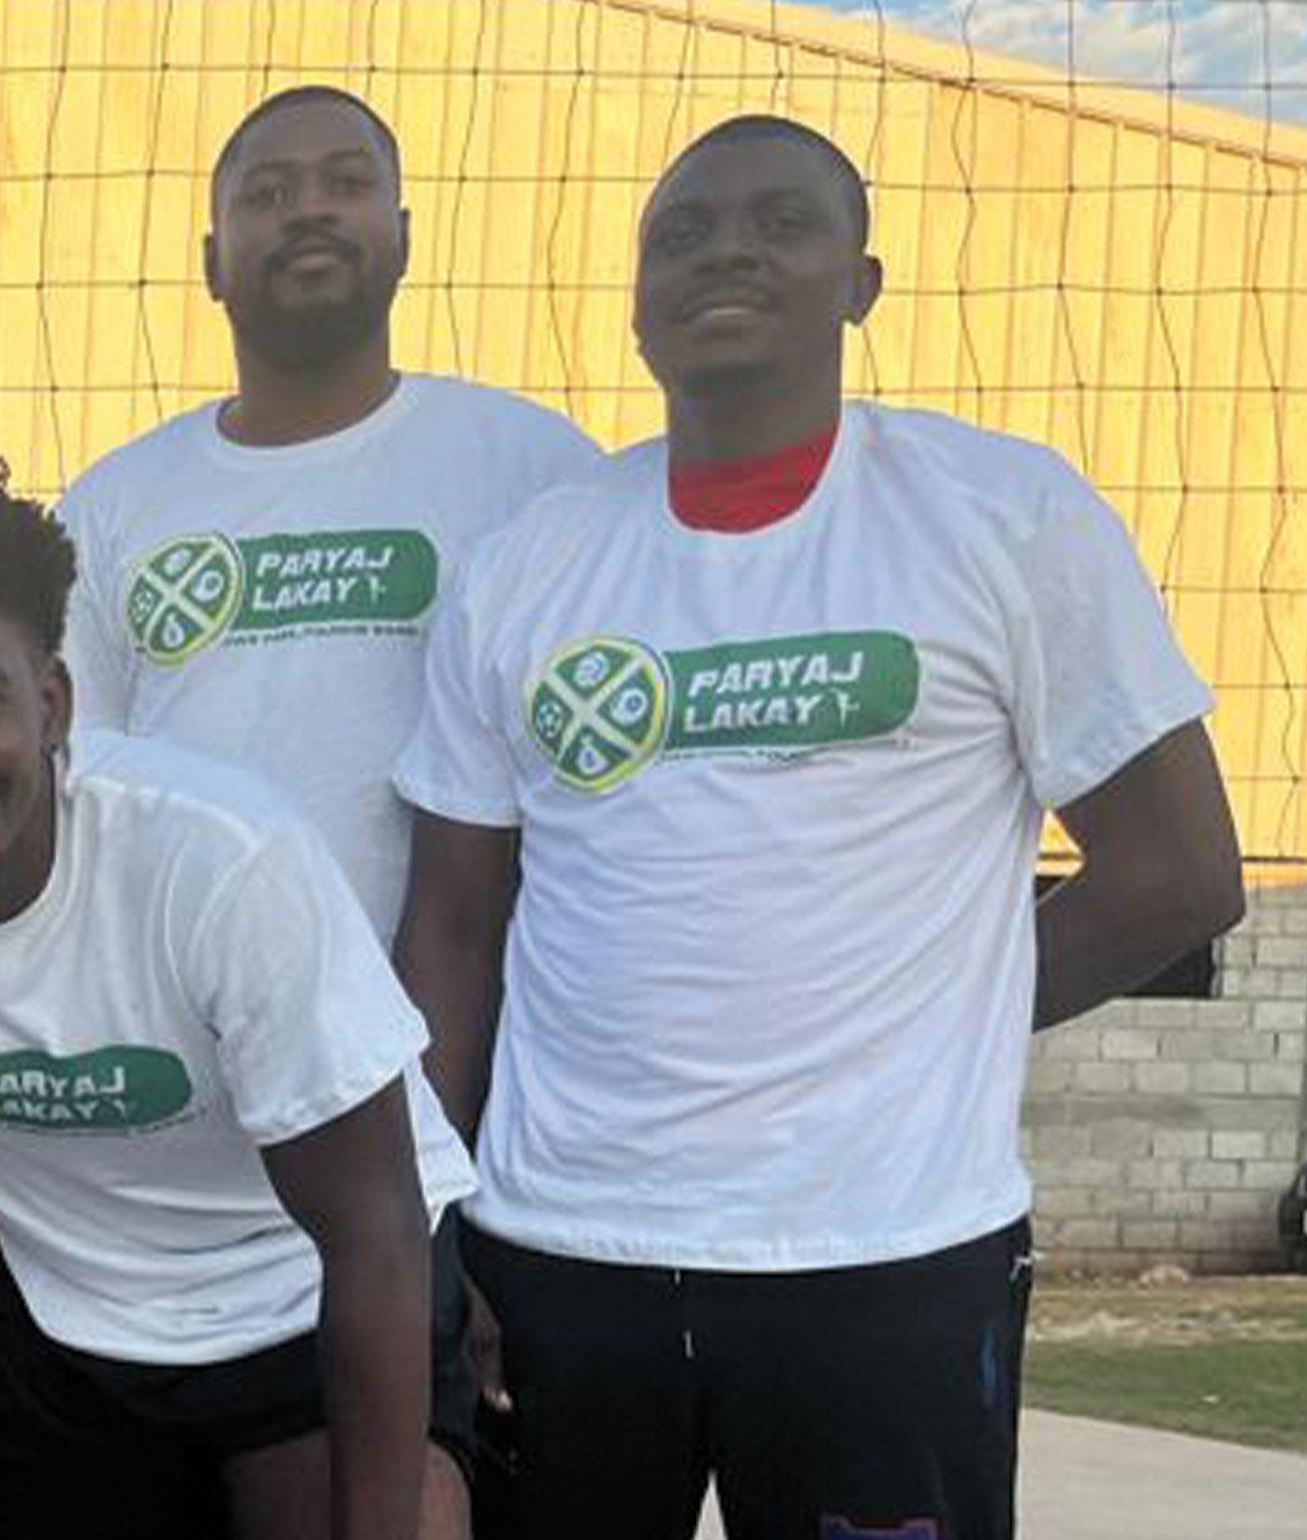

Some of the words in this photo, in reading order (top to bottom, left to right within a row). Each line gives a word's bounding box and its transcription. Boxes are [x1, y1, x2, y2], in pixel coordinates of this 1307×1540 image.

[256, 547, 393, 578] PARYAJ
[252, 576, 357, 611] LAKAY
[688, 651, 863, 698] PARYAJ
[684, 695, 822, 733] LAKAY
